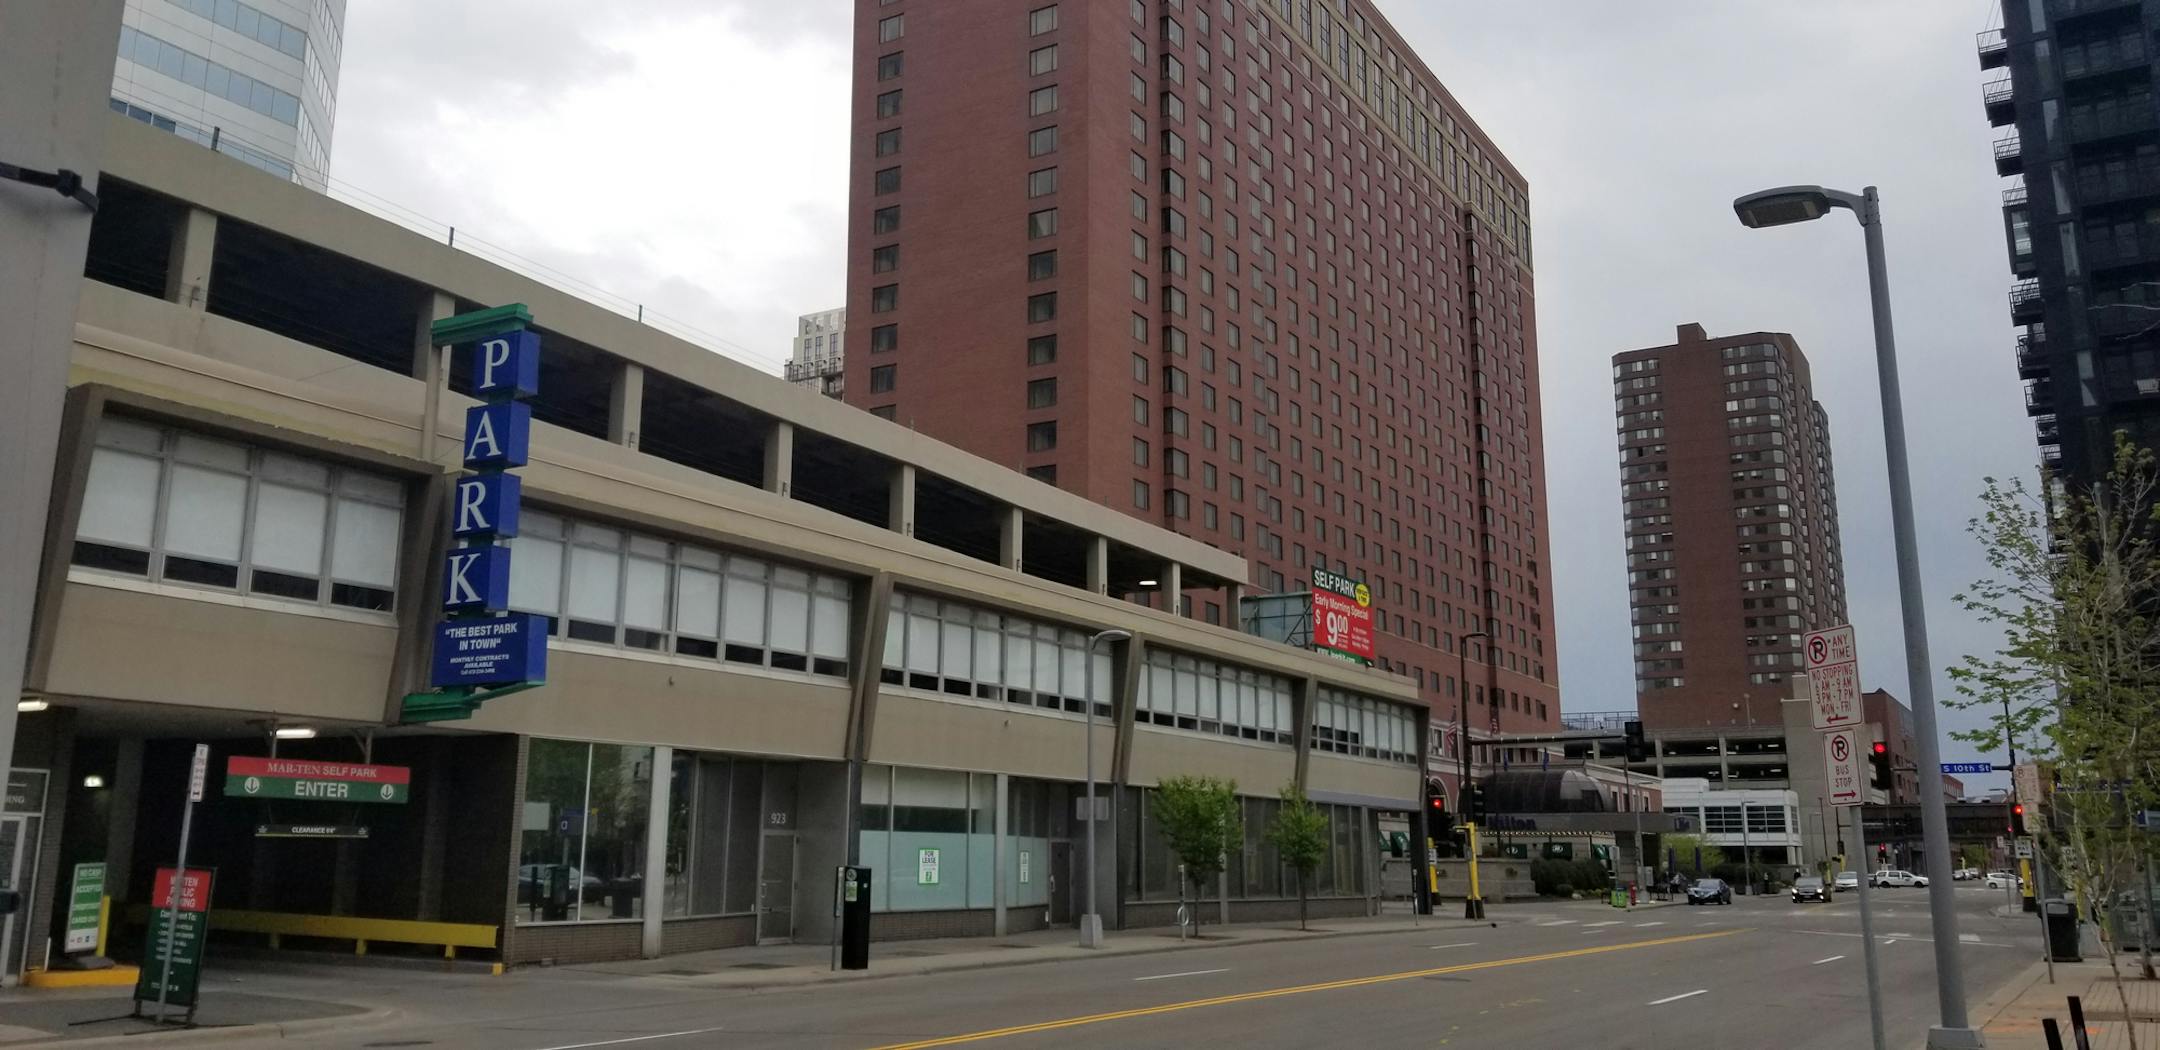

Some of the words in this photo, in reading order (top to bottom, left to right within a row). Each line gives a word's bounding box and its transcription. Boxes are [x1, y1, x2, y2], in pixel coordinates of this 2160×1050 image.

[445, 339, 510, 605] PARK
[1314, 569, 1334, 591] SELF
[1335, 577, 1356, 599] PARK
[1314, 592, 1328, 610] Early
[468, 625, 492, 637] BEST
[493, 622, 518, 634] PARK
[459, 641, 468, 651] IN
[1832, 633, 1848, 648] ANY
[450, 655, 474, 664] MONTHLY
[1832, 646, 1851, 659] TIME
[1811, 670, 1821, 681] NO
[1822, 663, 1853, 680] STOPPING
[1821, 680, 1831, 691] AM
[1843, 678, 1852, 688] AM
[1821, 691, 1831, 702] PM
[1844, 687, 1854, 699] PM
[1820, 703, 1835, 715] MON
[1841, 700, 1852, 713] FRI
[267, 762, 320, 776] MAR-TEN
[322, 766, 348, 777] SELF
[350, 767, 378, 778] PARK
[1835, 765, 1849, 775] BUS
[1943, 764, 1950, 772] S
[1953, 764, 1975, 772] 10th
[1978, 764, 1990, 772] St
[294, 781, 349, 798] ENTER
[1835, 777, 1852, 788] STOP
[770, 812, 786, 824] 923
[291, 826, 325, 834] CLEARANCE
